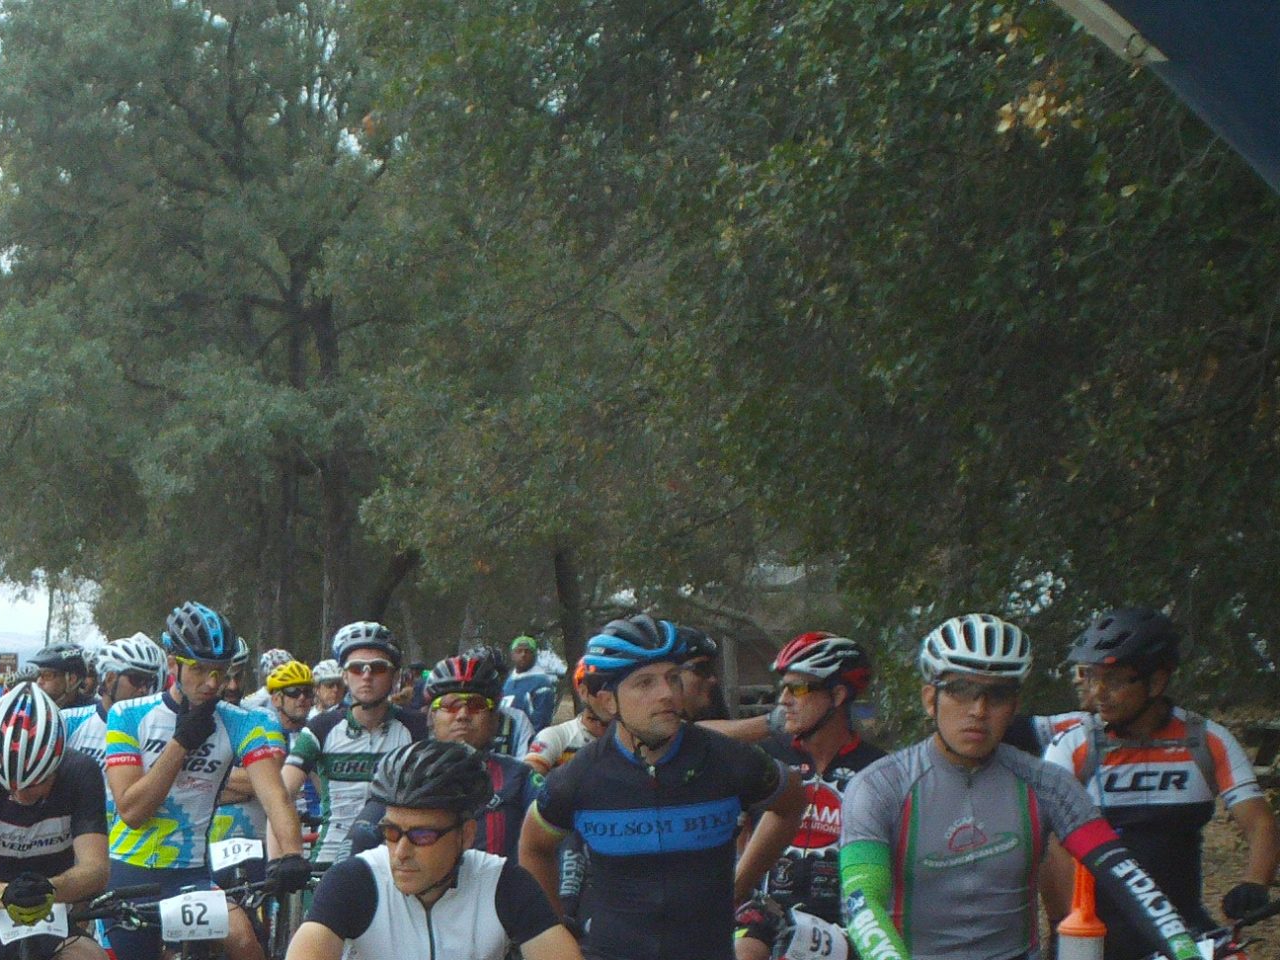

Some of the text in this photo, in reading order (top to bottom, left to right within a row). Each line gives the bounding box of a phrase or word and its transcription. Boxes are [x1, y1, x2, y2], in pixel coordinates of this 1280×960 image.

[1103, 770, 1190, 793] LCR
[584, 818, 673, 837] FOLSOM
[684, 811, 735, 833] BIKE
[222, 844, 253, 858] 107
[1110, 858, 1187, 938] BICYCLE
[181, 903, 209, 927] 62
[810, 927, 833, 957] 93
